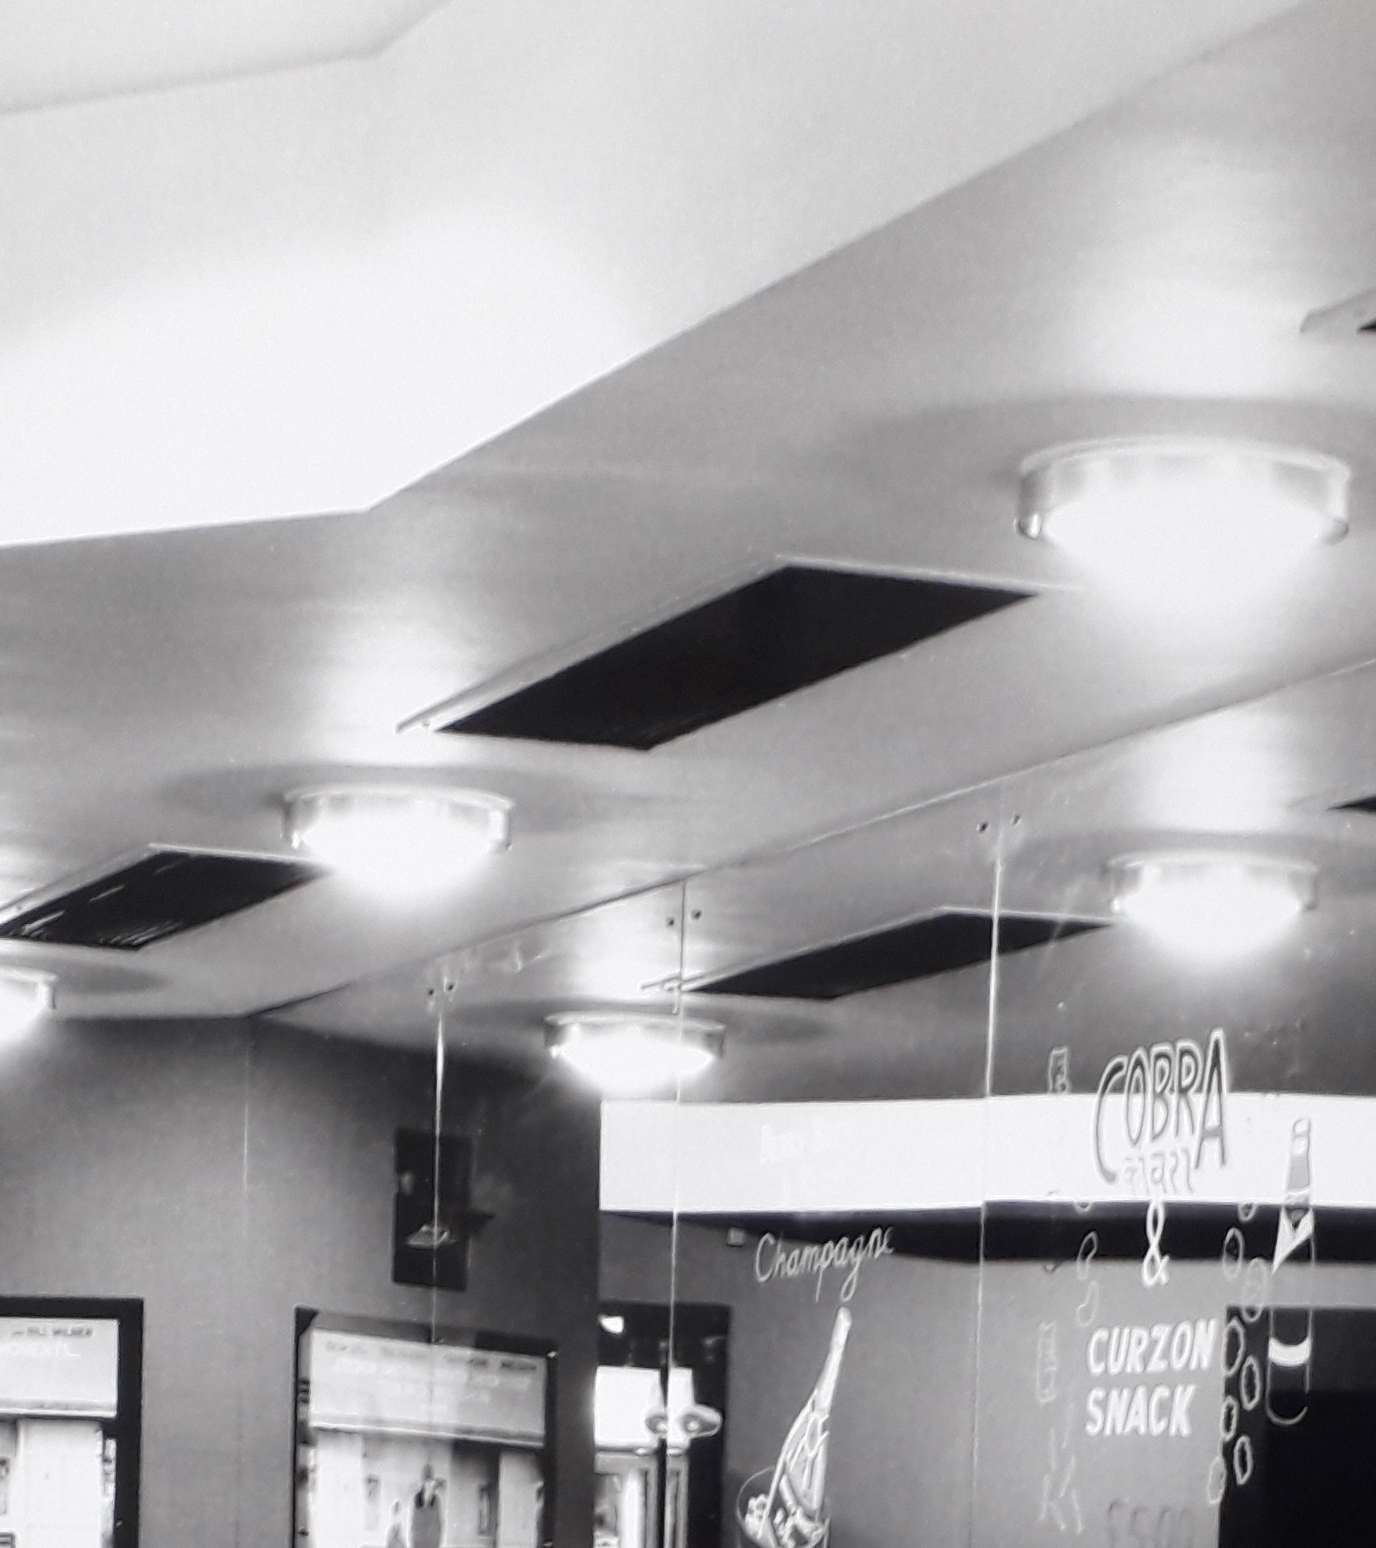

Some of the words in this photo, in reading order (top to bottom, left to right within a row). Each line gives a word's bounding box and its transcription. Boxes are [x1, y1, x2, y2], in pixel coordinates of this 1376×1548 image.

[1093, 1027, 1228, 1185] COBRA
[755, 1226, 895, 1303] Champagne
[1141, 1193, 1170, 1287] &
[1087, 1318, 1219, 1376] CURZON
[1085, 1384, 1196, 1438] SNACK
